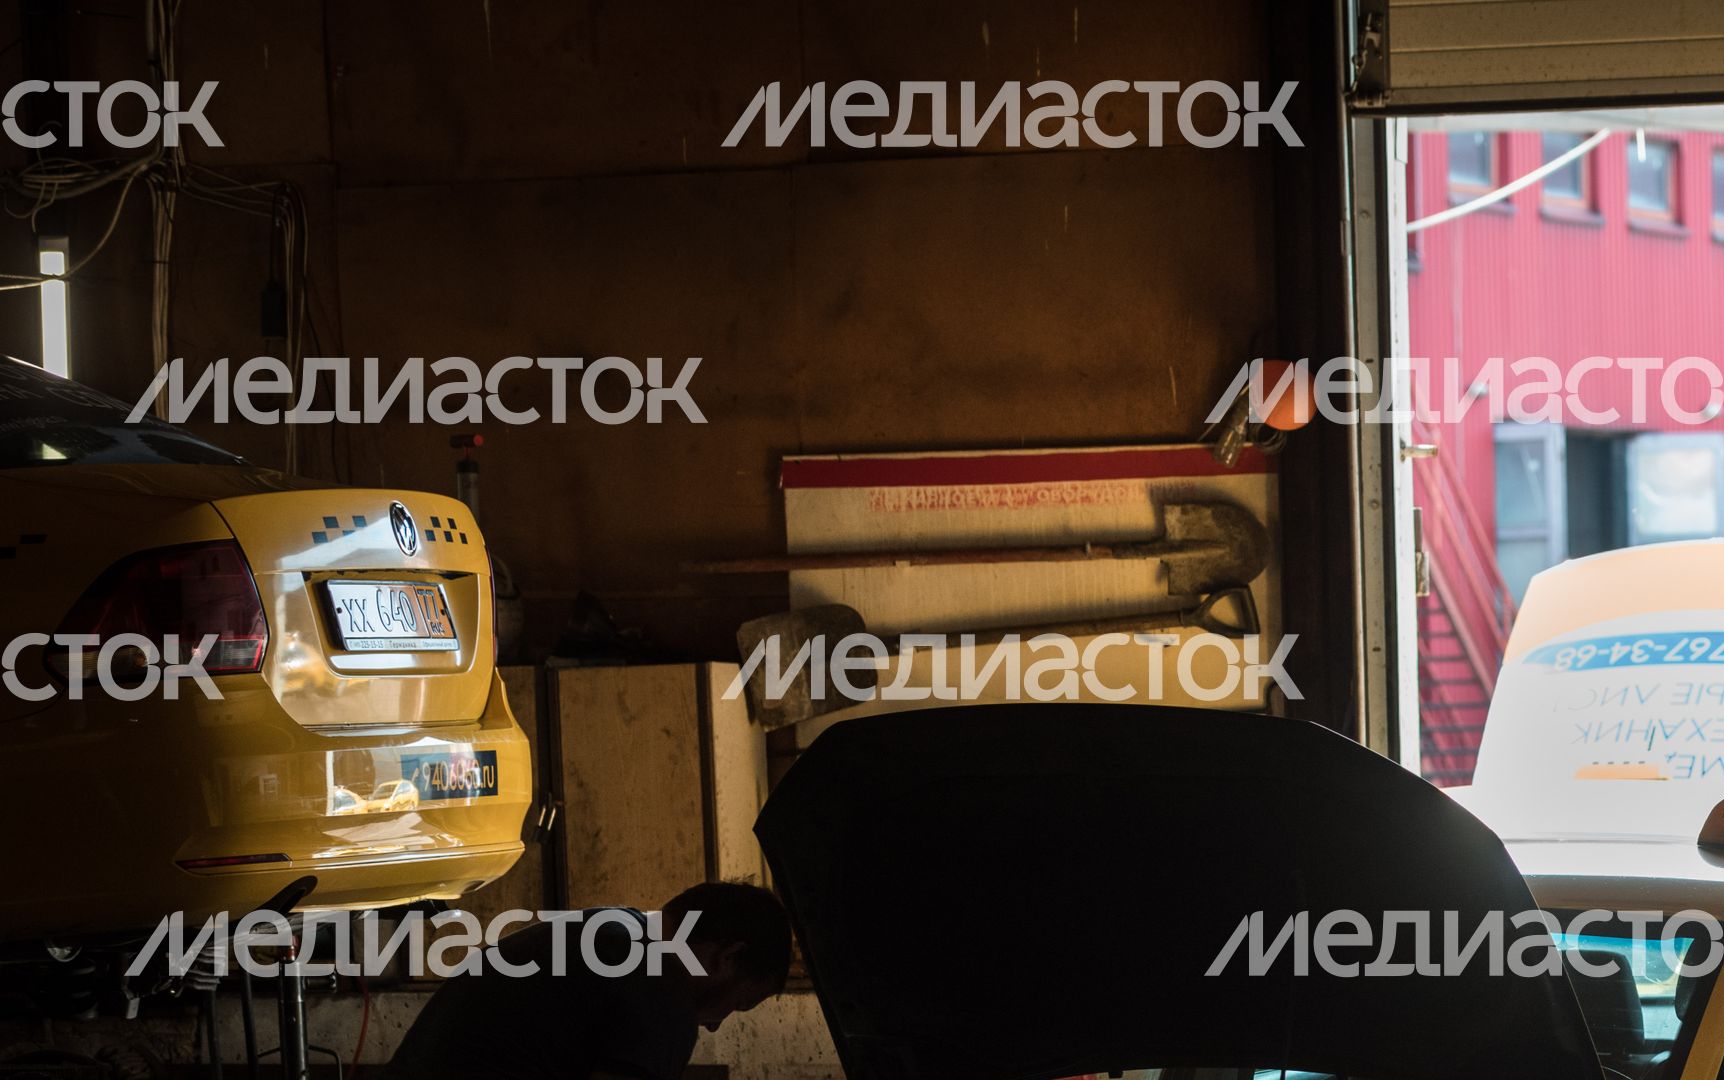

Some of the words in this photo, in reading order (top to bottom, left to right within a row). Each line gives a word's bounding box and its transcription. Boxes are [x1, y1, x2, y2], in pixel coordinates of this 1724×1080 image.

[376, 587, 417, 633] 640
[417, 589, 439, 621] 77
[1553, 684, 1662, 713] ЛИС
